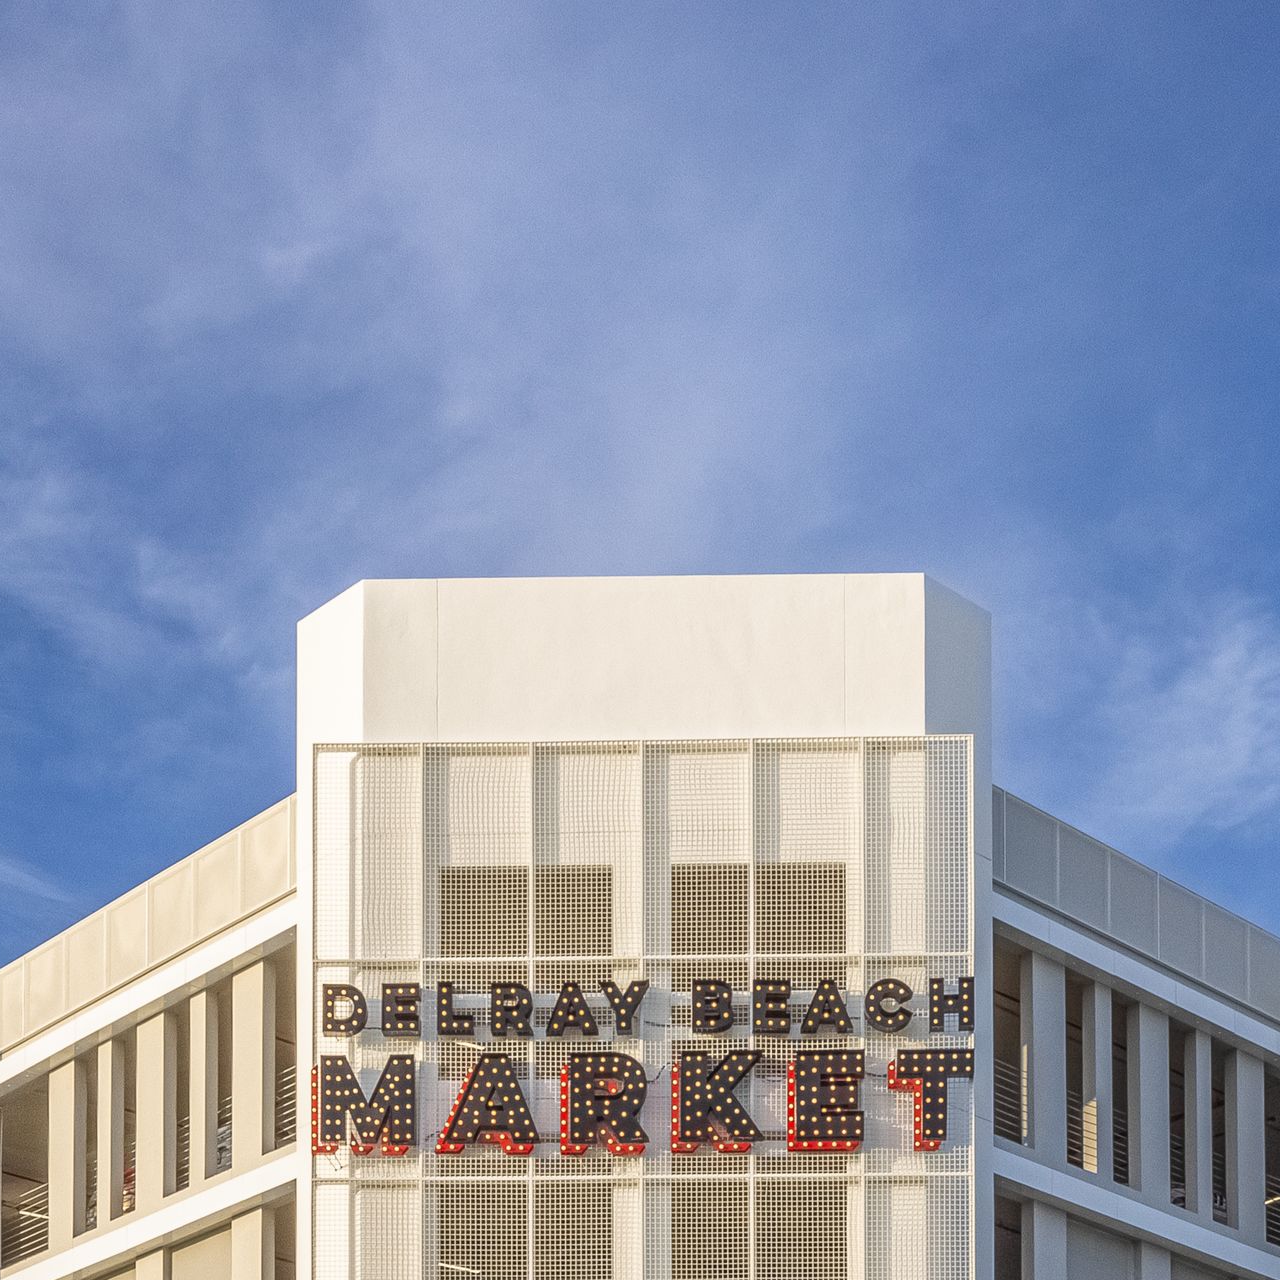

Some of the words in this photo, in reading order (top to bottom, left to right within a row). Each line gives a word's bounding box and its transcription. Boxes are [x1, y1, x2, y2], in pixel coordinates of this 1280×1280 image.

[322, 979, 649, 1037] DELRAY
[692, 977, 975, 1034] BEACH
[311, 1048, 975, 1154] MARKET
